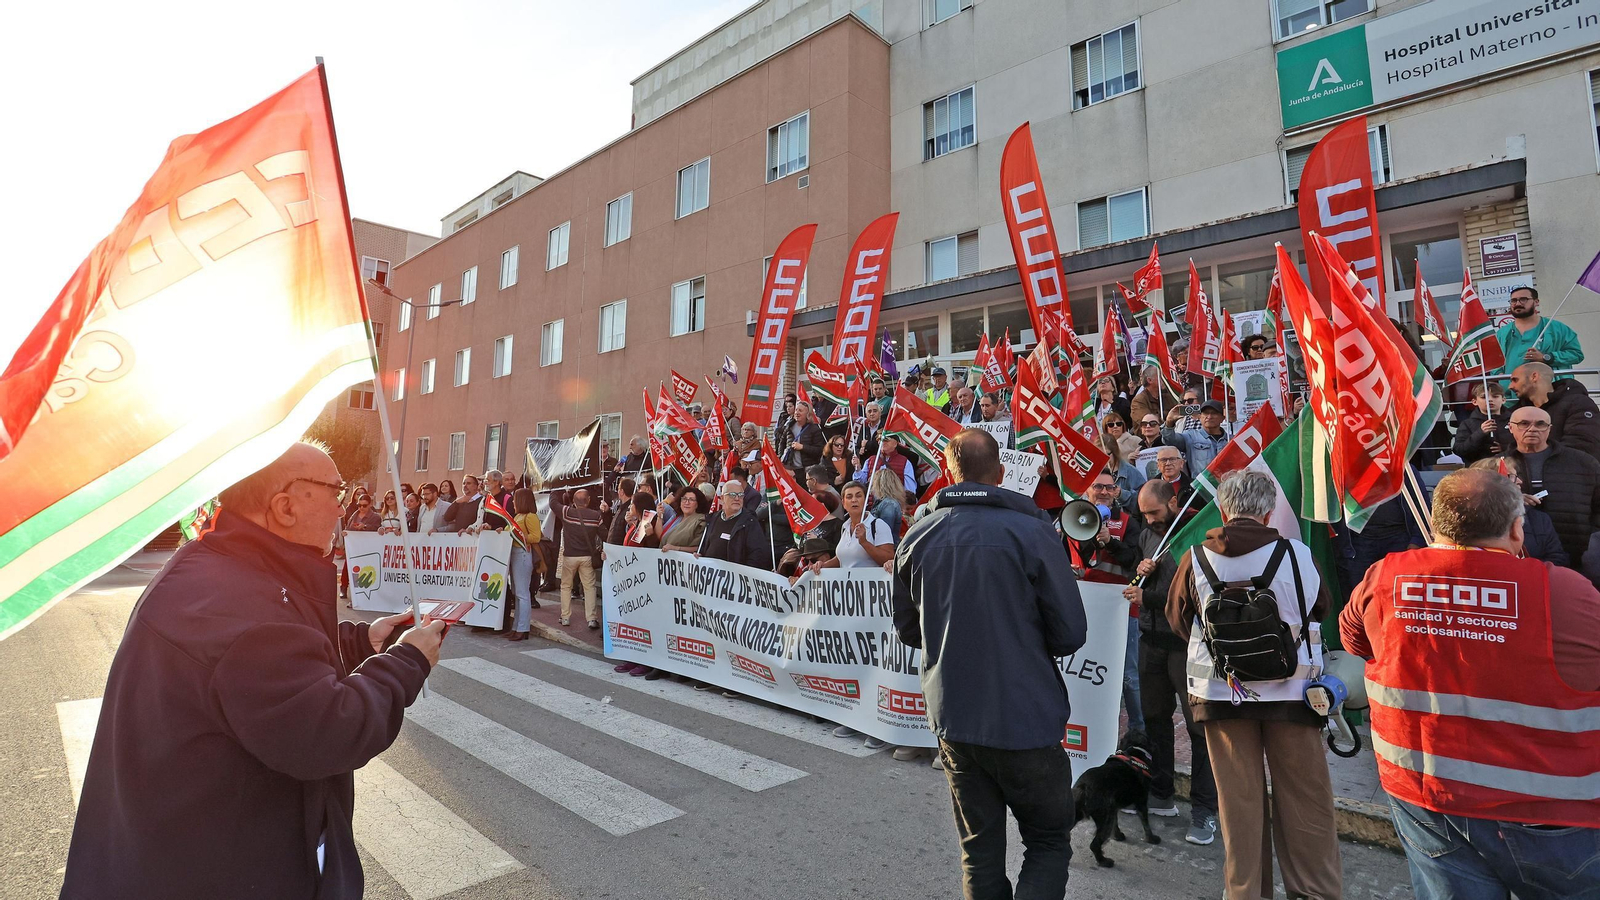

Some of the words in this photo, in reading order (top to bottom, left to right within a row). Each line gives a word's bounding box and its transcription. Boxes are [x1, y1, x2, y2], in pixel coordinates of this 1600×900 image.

[1385, 28, 1461, 62] Hospital
[1466, 0, 1580, 37] Universita
[1387, 50, 1465, 84] Hospital
[1470, 26, 1557, 61] Materno
[1577, 13, 1600, 29] In
[1288, 96, 1311, 106] Junta
[1323, 80, 1364, 96] Andalucía
[754, 258, 801, 375] CCOO
[1338, 390, 1391, 473] Cádiz
[391, 546, 421, 570] DEFESA
[422, 546, 431, 570] DE
[432, 547, 443, 571] LA
[610, 559, 624, 575] POR
[625, 552, 639, 567] LA
[384, 572, 421, 586] UNIVERSL,
[422, 574, 454, 587] GRATUITA
[454, 576, 459, 586] Y
[459, 576, 466, 587] DE
[612, 572, 646, 597] SANIDAD
[658, 558, 678, 587] POR
[688, 563, 735, 601] HOSPITAL
[738, 573, 752, 605] DE
[753, 578, 784, 613] JEREZ
[807, 571, 865, 617] ATENCIÓN
[869, 580, 892, 617] PRI
[618, 593, 653, 617] PÚBLICA
[1401, 582, 1508, 610] CCOO
[674, 597, 687, 625] DE
[708, 609, 739, 645] COSTA
[740, 618, 797, 660] NOROESTE
[806, 628, 858, 664] SIERRA
[855, 631, 879, 667] DE
[1394, 609, 1442, 622] sanidad
[1446, 615, 1453, 625] y
[1457, 616, 1518, 630] sectores
[620, 627, 644, 639] CCOO
[1405, 624, 1506, 643] sociosanitarios
[679, 640, 706, 654] CCOO
[738, 658, 764, 675] CCOO
[1056, 653, 1108, 686] ALES
[808, 678, 846, 694] CCOO
[1068, 751, 1087, 760] tores
